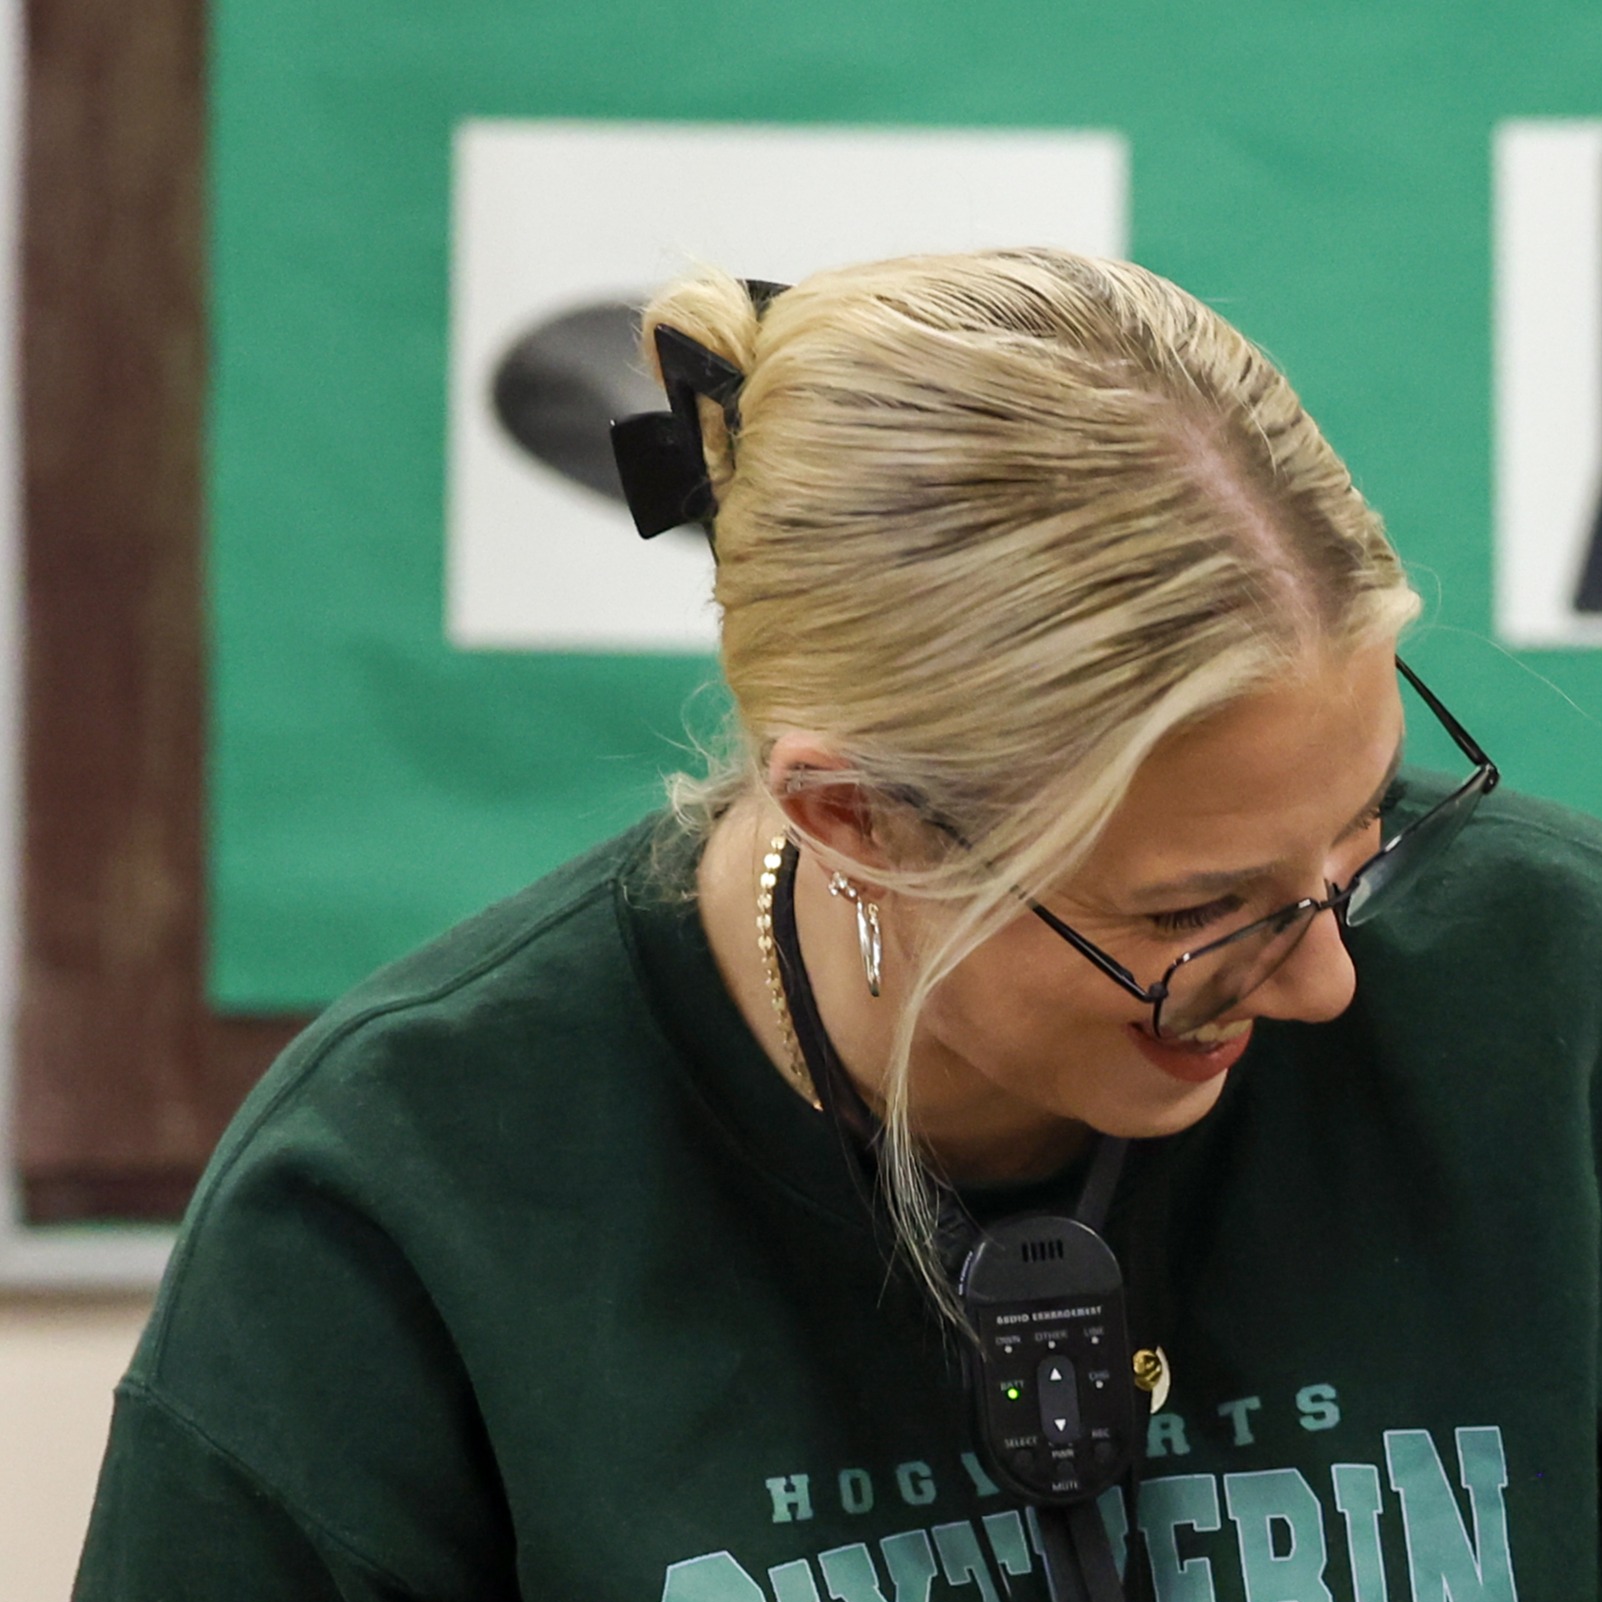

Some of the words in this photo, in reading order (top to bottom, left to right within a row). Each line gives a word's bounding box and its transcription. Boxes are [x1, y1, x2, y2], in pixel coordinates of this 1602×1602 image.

[996, 1313, 1029, 1325] AUDIO
[1031, 1305, 1102, 1321] ENHANCEMENT
[1034, 1329, 1067, 1342] OTHER
[1001, 1380, 1024, 1391] BATT
[1004, 1436, 1038, 1449] SELECT
[765, 1383, 1341, 1523] HOGRTS
[1051, 1480, 1078, 1492] MUTE
